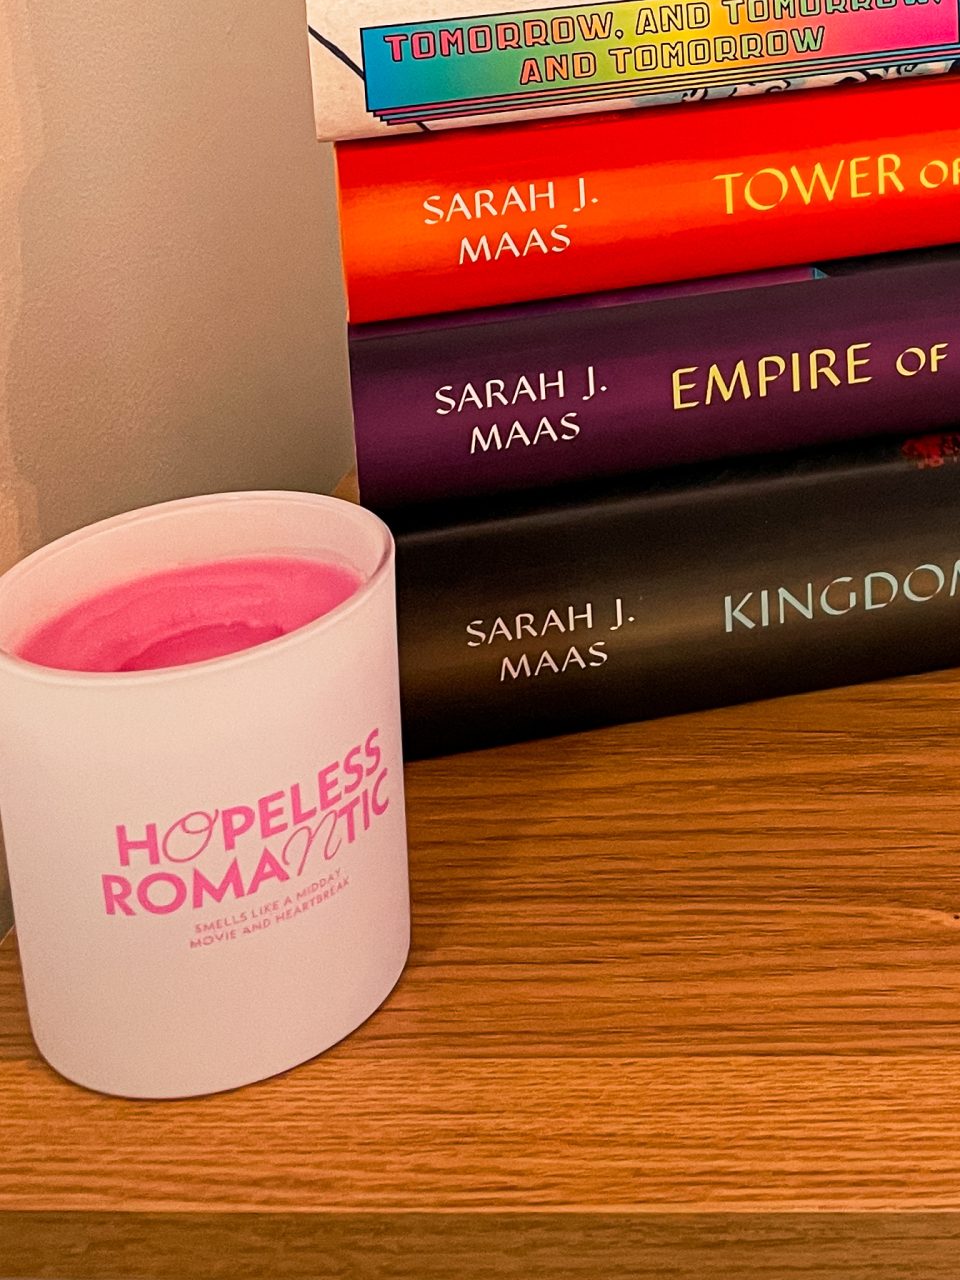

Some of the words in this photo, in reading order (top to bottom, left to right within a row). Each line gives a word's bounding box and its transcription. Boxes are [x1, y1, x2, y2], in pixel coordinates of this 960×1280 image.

[383, 10, 624, 63] TOMORROW,
[636, 1, 710, 35] AND
[519, 51, 597, 87] AND
[609, 26, 825, 76] TOMORROW
[422, 180, 556, 225] SARAH
[572, 177, 599, 213] J.
[713, 153, 906, 215] TOWER
[458, 224, 572, 265] MAAS
[434, 370, 566, 416] SARAH
[582, 366, 608, 401] J.
[671, 342, 873, 411] EMPIRE
[895, 342, 949, 377] OF
[469, 412, 581, 455] MAAS
[465, 602, 594, 648] SARAH
[609, 598, 635, 630] J.
[499, 641, 609, 682] MAAS
[115, 727, 382, 867] HOPELESS
[101, 767, 390, 917] ROMANTIC
[189, 929, 237, 949] MOVIE
[242, 918, 271, 935] AND
[275, 875, 350, 924] HEARTBREAK
[194, 912, 248, 934] SMELLS
[251, 900, 280, 919] LIKE
[283, 895, 293, 907] A
[296, 867, 342, 899] MIDDAY
